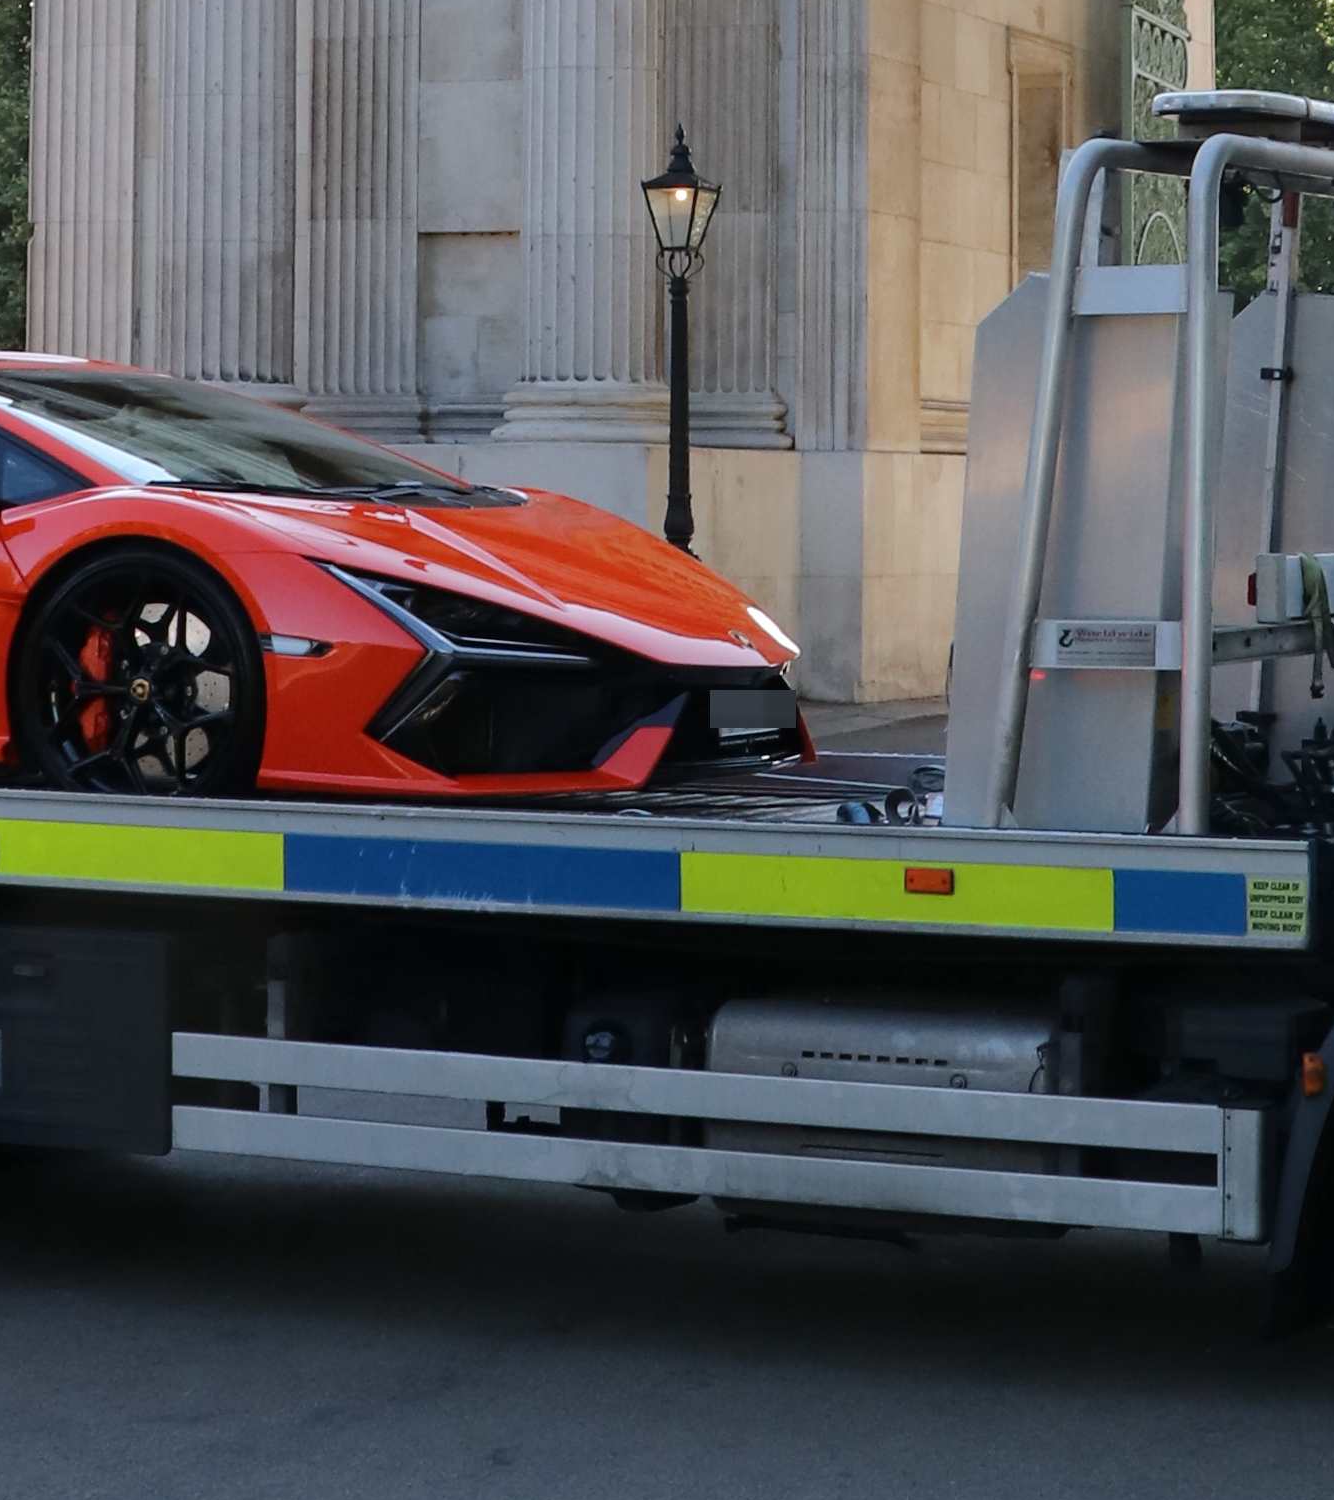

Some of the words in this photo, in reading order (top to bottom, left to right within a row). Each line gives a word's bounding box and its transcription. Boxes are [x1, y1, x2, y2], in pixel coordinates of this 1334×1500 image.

[1075, 629, 1151, 639] Worldwide
[1253, 881, 1269, 890] KEEP
[1270, 882, 1290, 890] CLEAR
[1291, 882, 1300, 891] OF
[1287, 896, 1304, 904] BODY
[1249, 910, 1268, 918] KEEP
[1270, 911, 1293, 919] CLEAR
[1295, 911, 1304, 920] OF
[1252, 922, 1281, 931] MOVING
[1282, 924, 1302, 932] BODY
